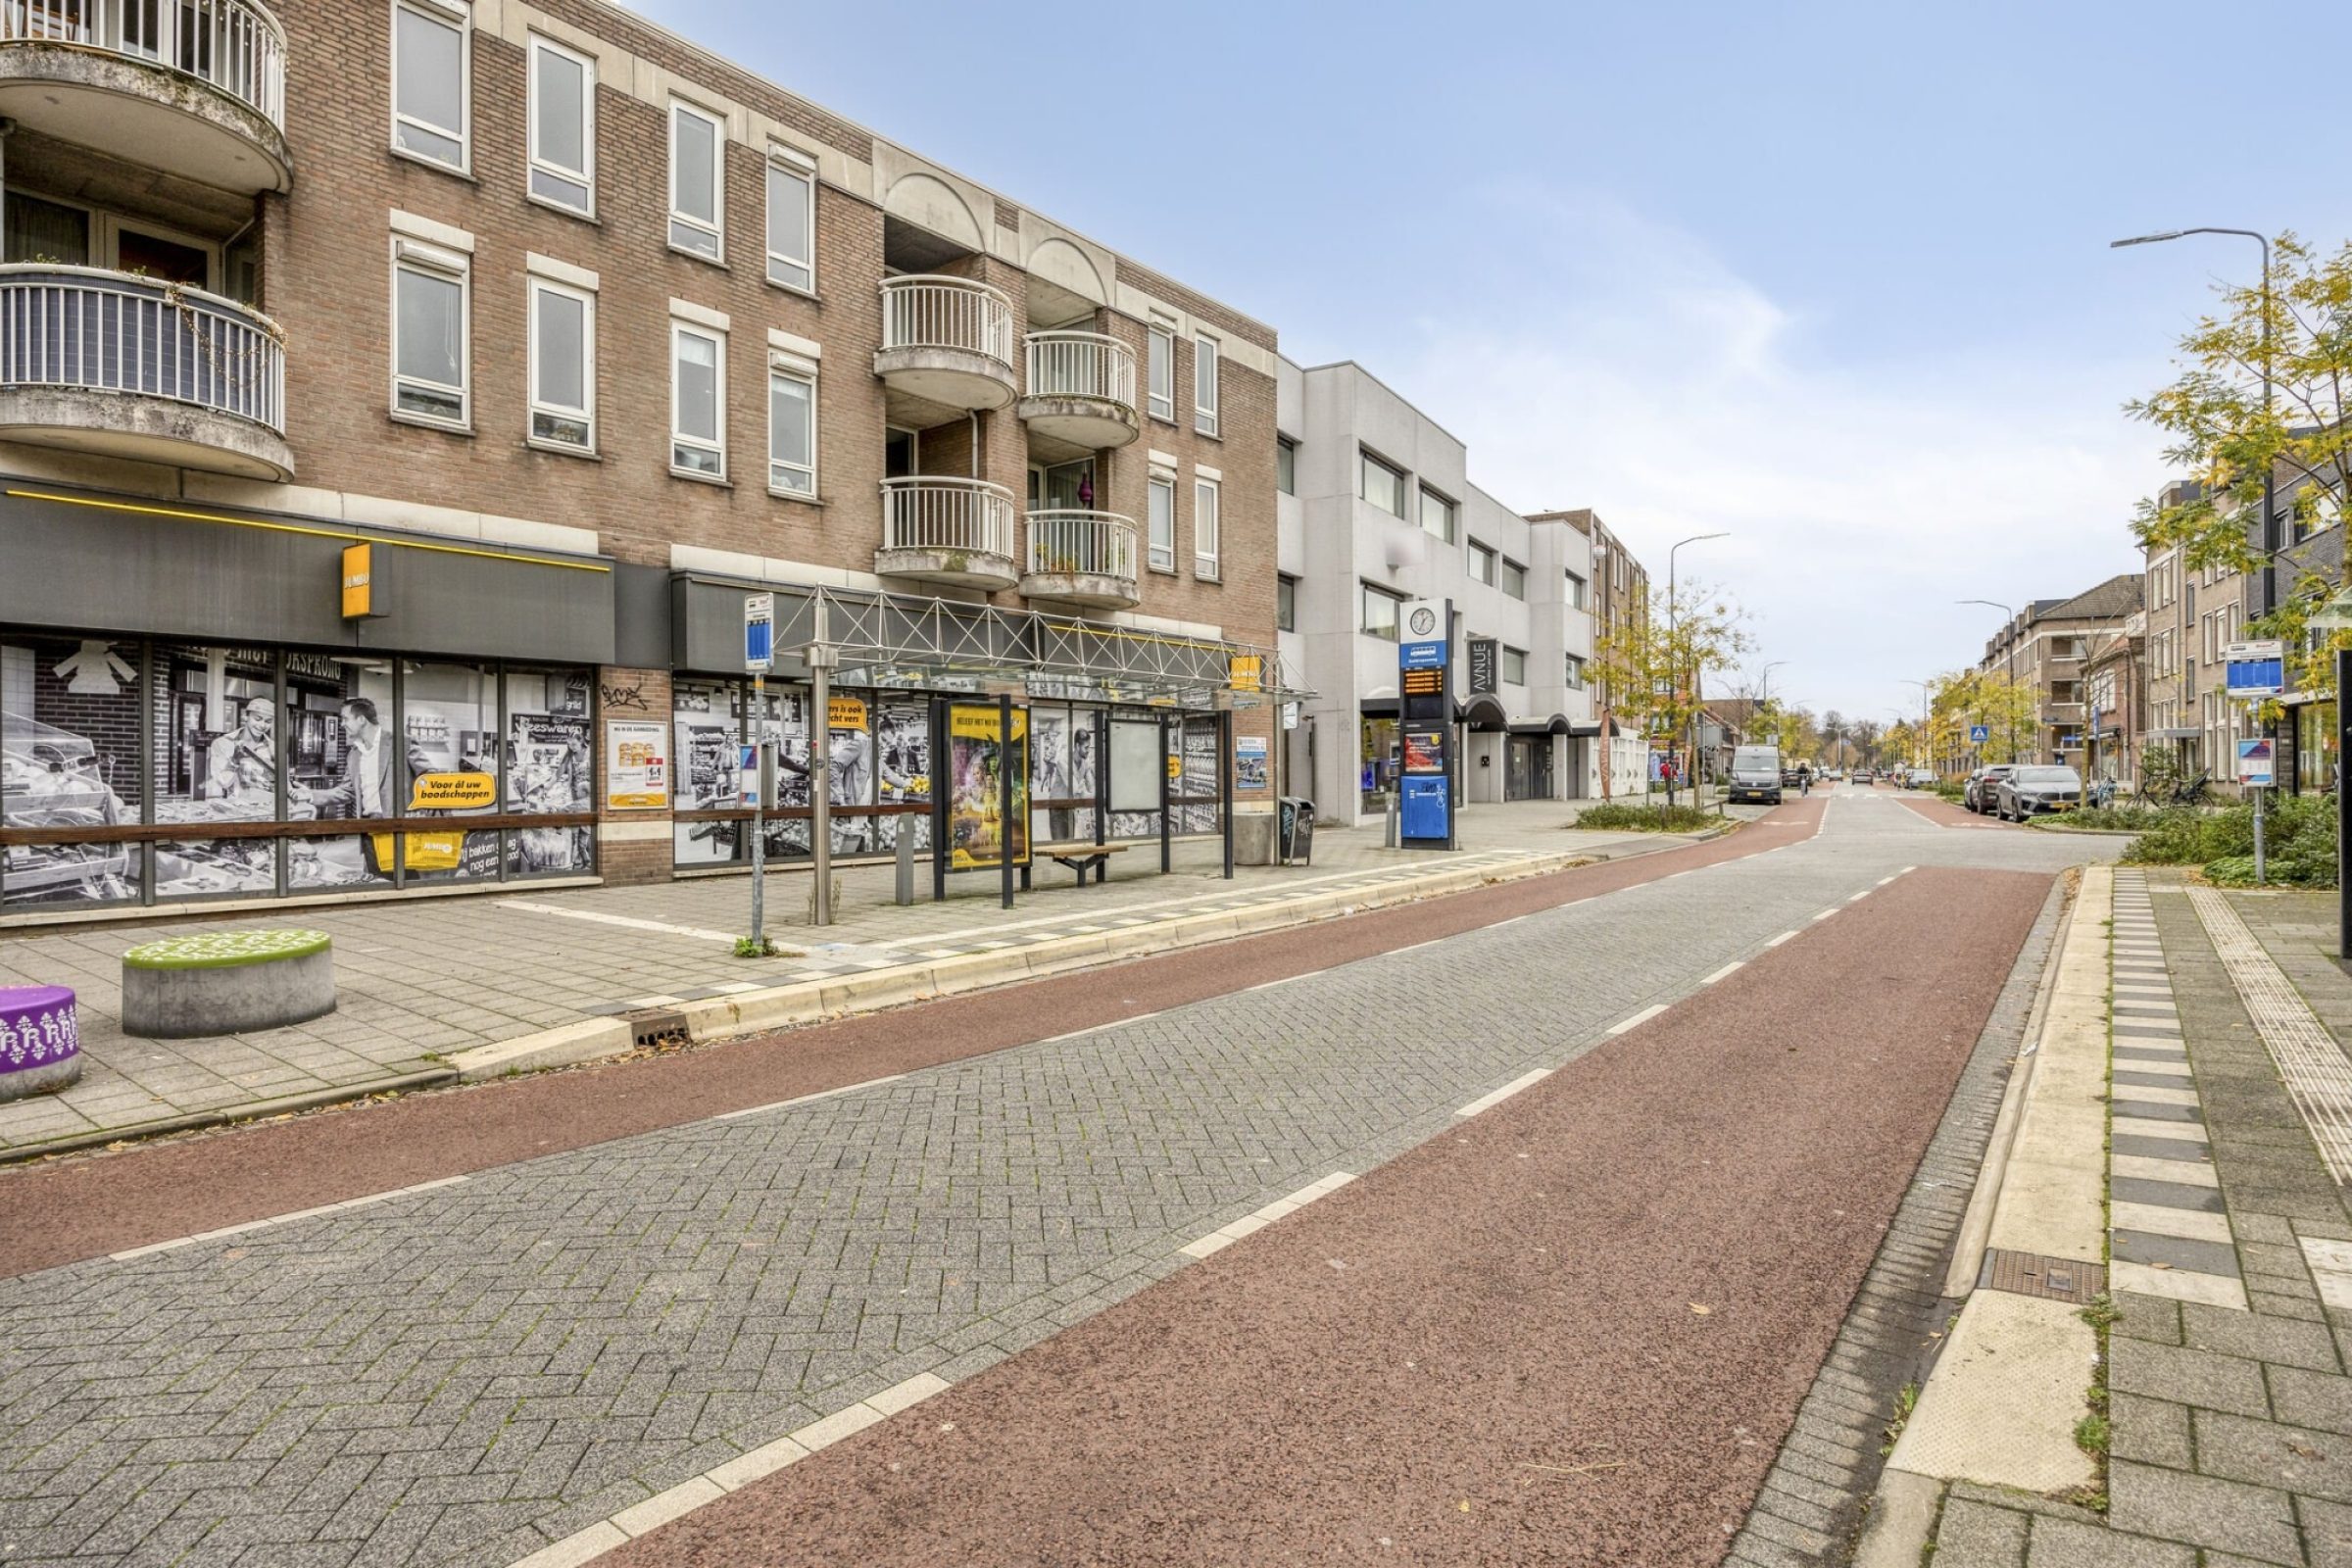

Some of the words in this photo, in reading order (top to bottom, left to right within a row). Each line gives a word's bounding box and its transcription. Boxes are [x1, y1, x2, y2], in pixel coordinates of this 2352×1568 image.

[1473, 643, 1486, 691] AVNUE
[840, 704, 847, 712] is
[848, 705, 862, 713] ook
[430, 780, 453, 789] Voor
[455, 780, 466, 789] ál
[420, 790, 490, 800] boodschappen
[468, 843, 495, 858] bakken
[469, 859, 485, 872] nog
